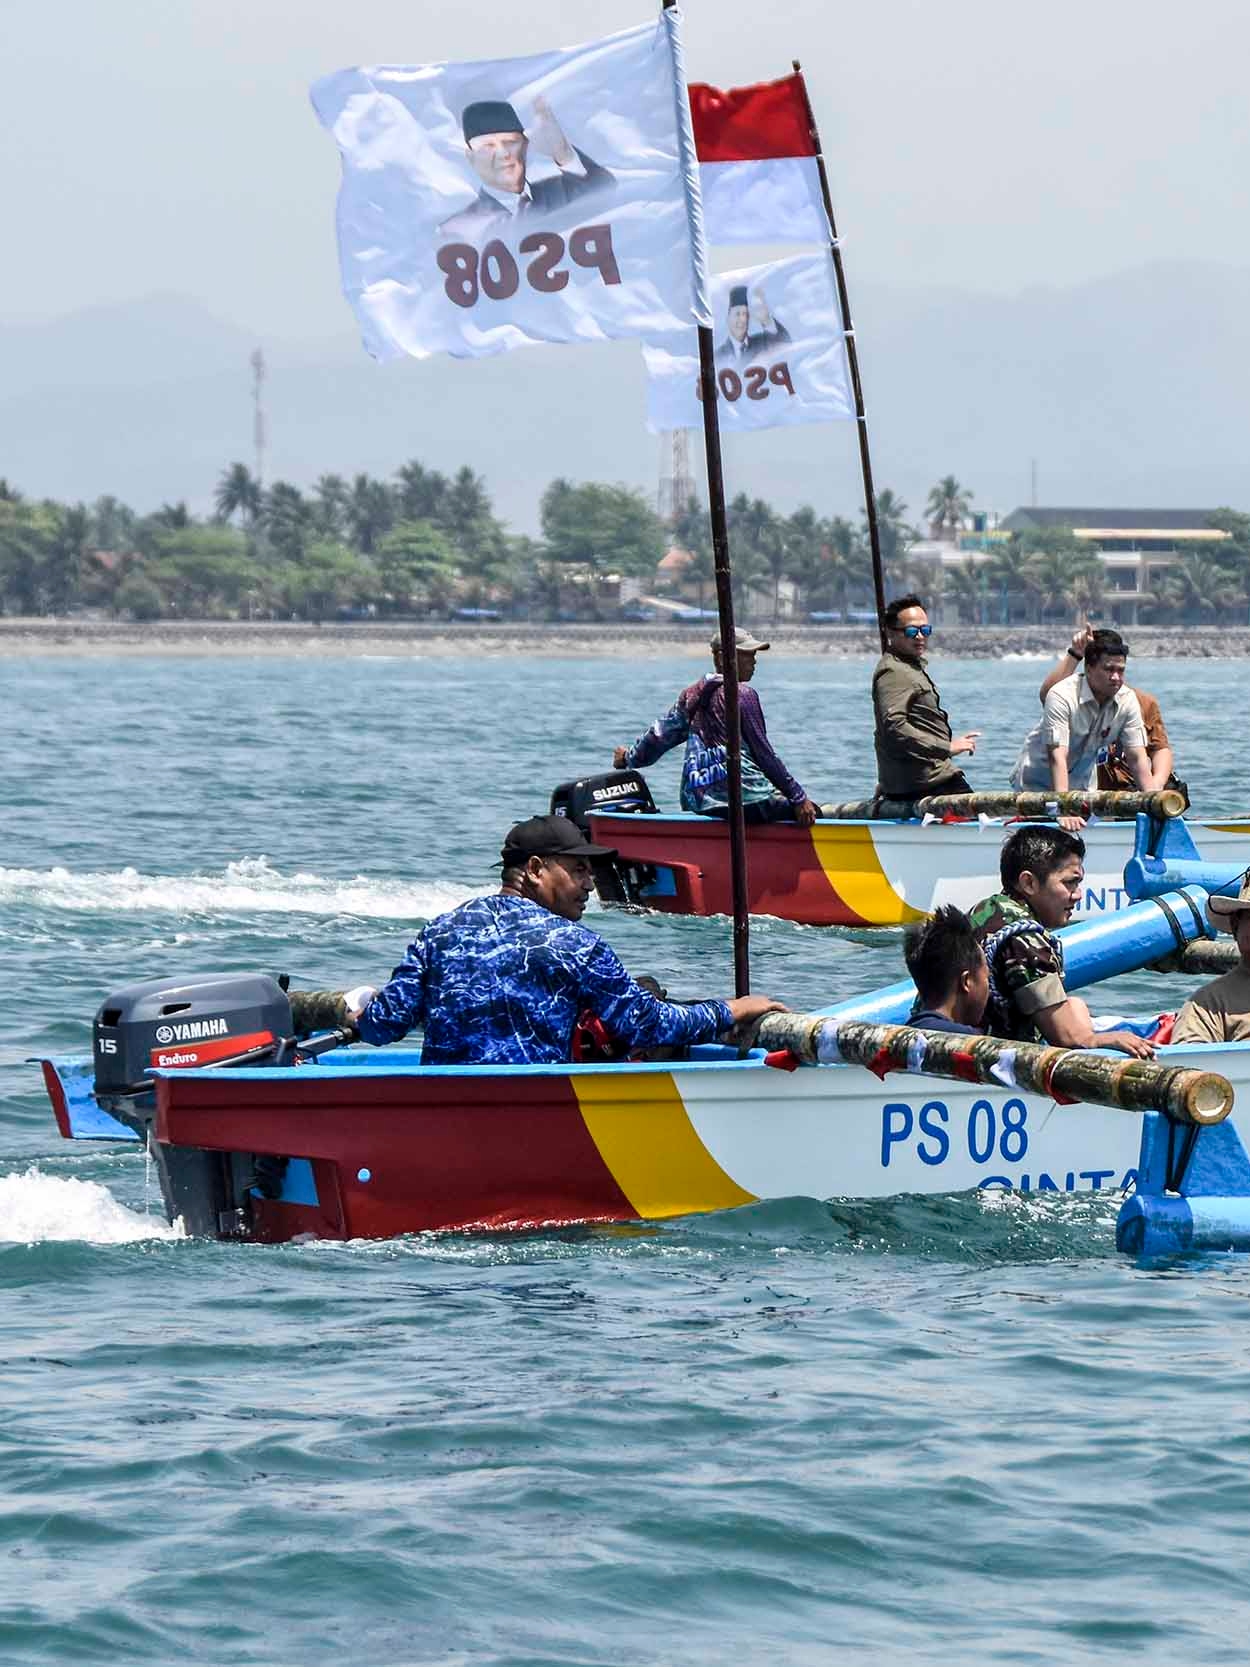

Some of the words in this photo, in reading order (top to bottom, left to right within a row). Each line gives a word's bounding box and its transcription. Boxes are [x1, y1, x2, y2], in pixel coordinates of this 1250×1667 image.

[592, 782, 639, 801] SUZUKI
[172, 1018, 229, 1041] YAMAHA
[98, 1038, 118, 1054] 15
[158, 1052, 198, 1067] Enduro
[881, 1101, 950, 1168] PS
[968, 1098, 1029, 1165] 08
